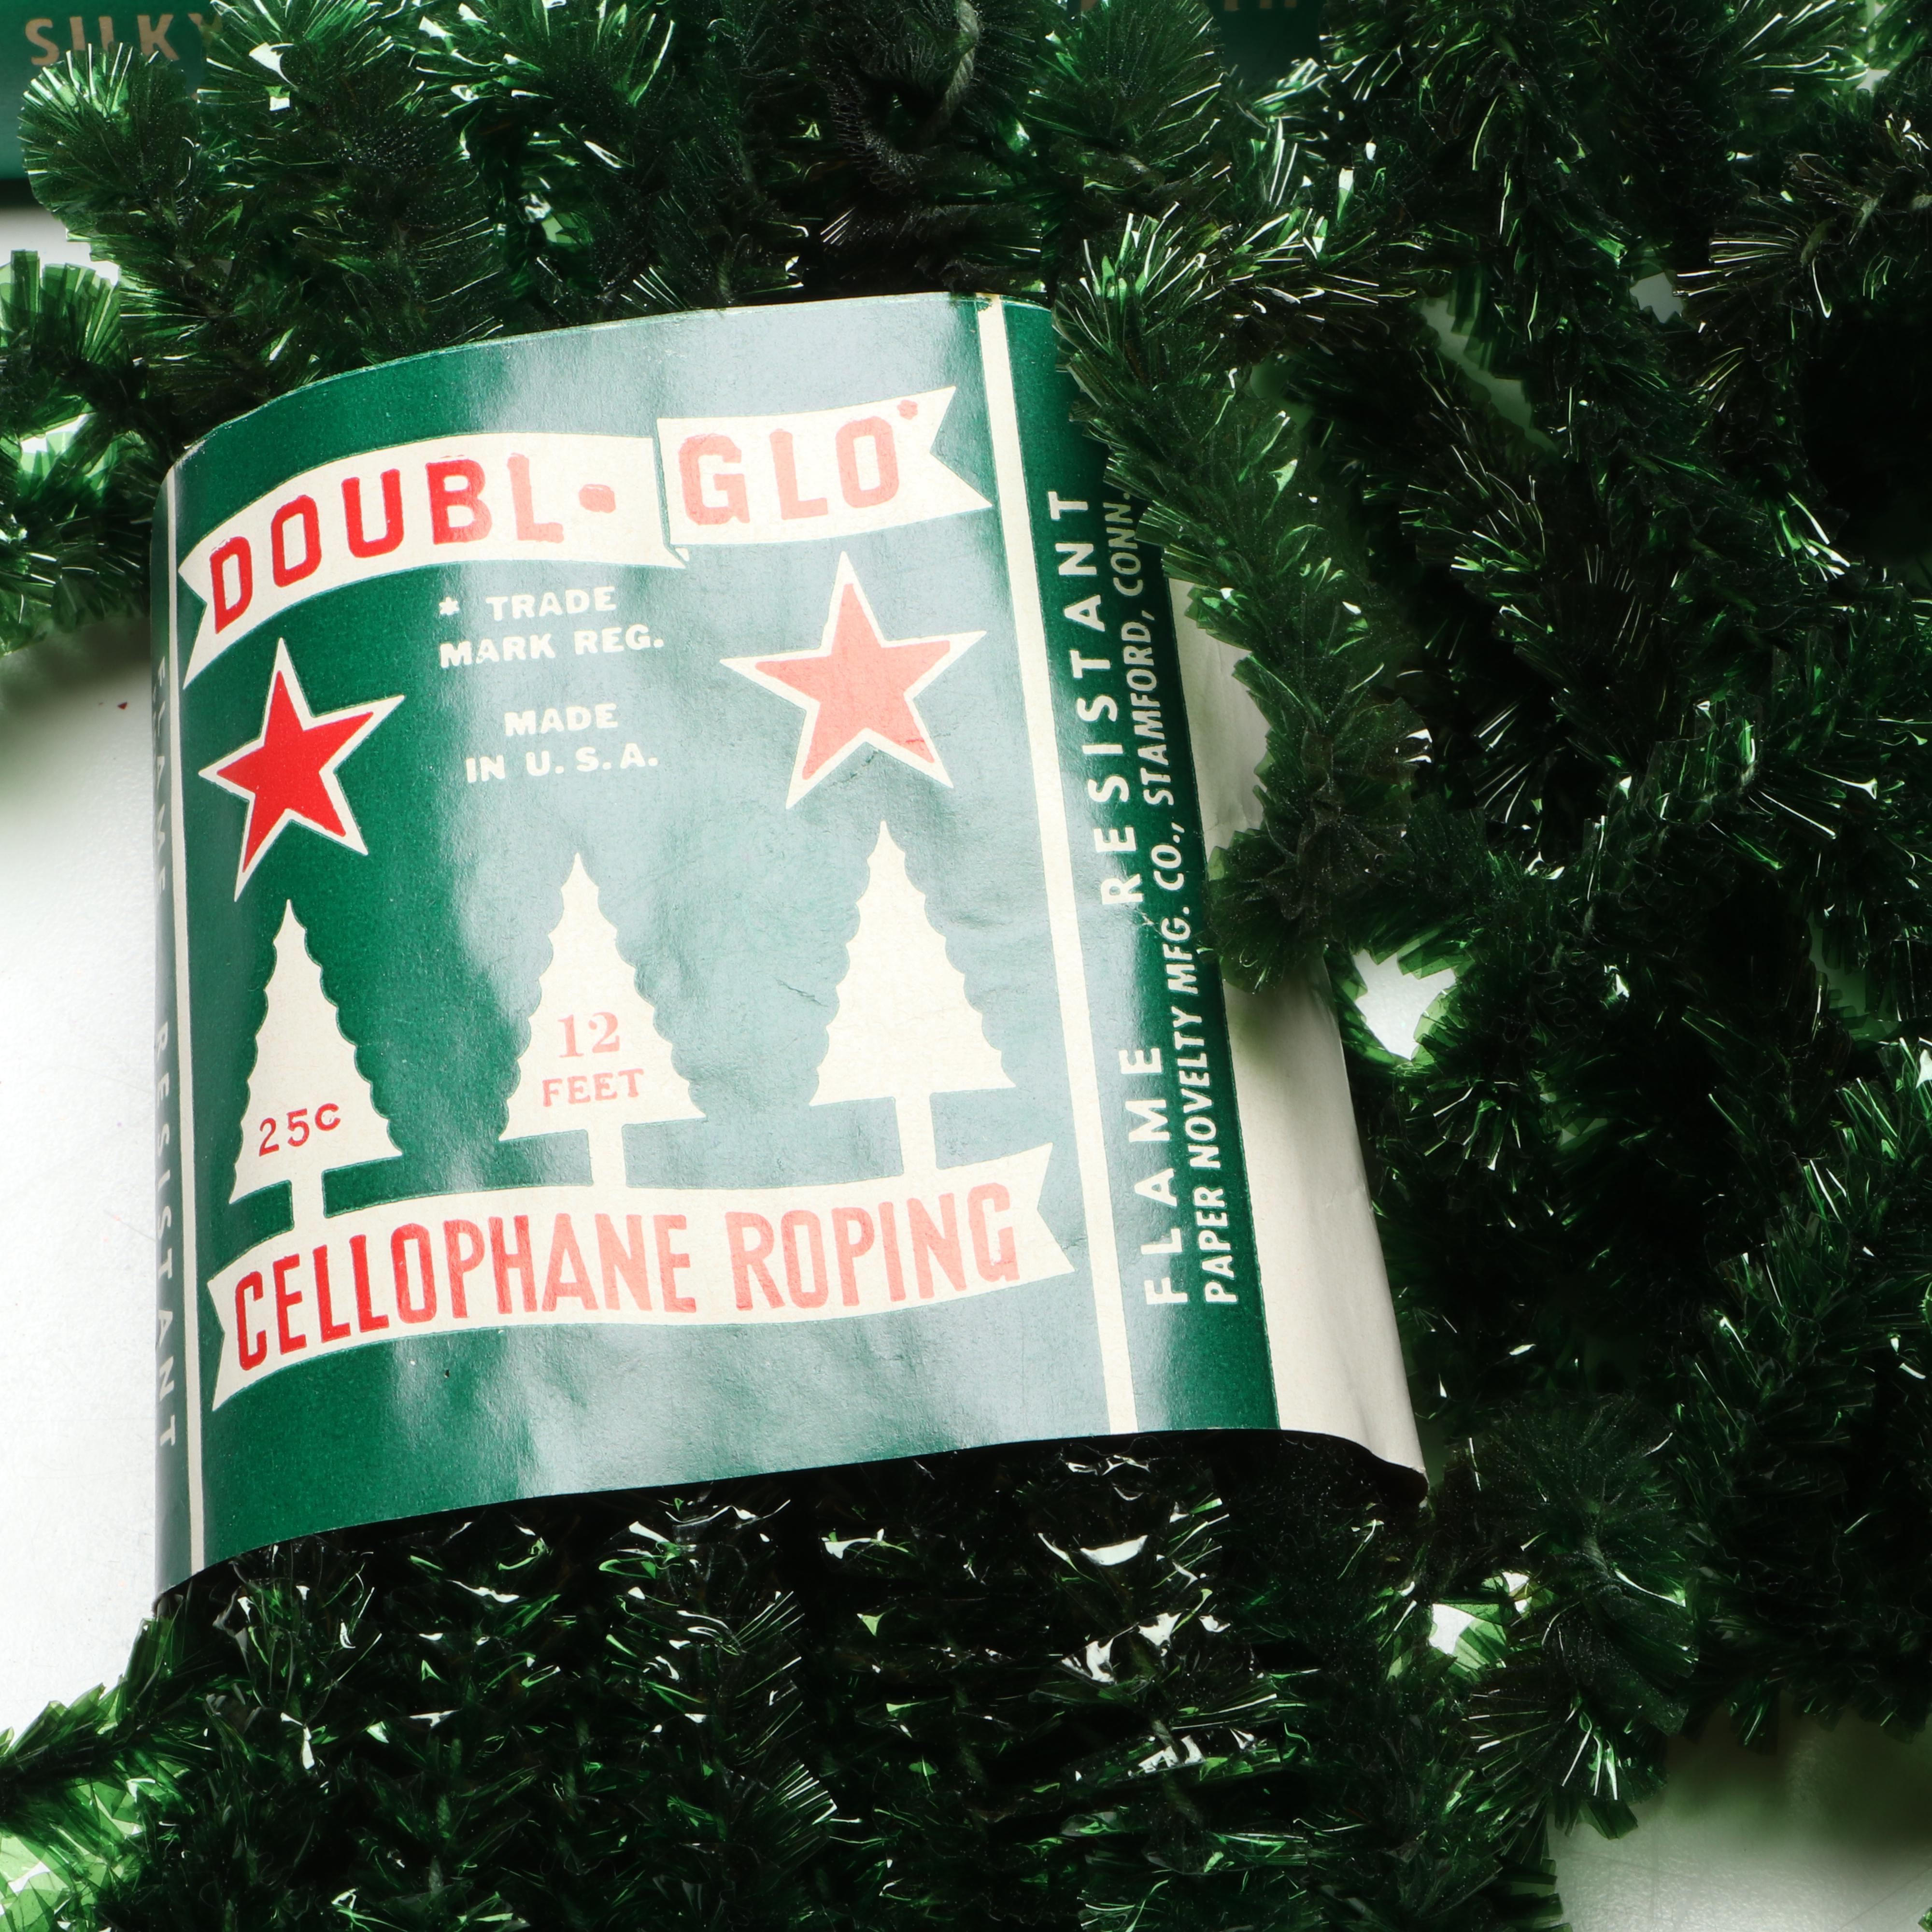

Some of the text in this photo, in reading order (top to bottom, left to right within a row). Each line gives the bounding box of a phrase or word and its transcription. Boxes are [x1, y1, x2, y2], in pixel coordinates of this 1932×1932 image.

[486, 586, 616, 621] TRADE
[440, 624, 664, 668] MARK REG.
[504, 703, 618, 737] MADE
[466, 754, 505, 783] IN
[1048, 491, 1188, 1304] FLAME RESISTANT
[1103, 493, 1237, 1303] PAPER NOVELTY MFG. CO., STAMFORD, CONN.
[557, 1011, 620, 1058] 12
[542, 1068, 644, 1107] FEET
[156, 1023, 175, 1448] RESISTANT
[235, 1182, 1020, 1371] CELLOPHANE ROPING
